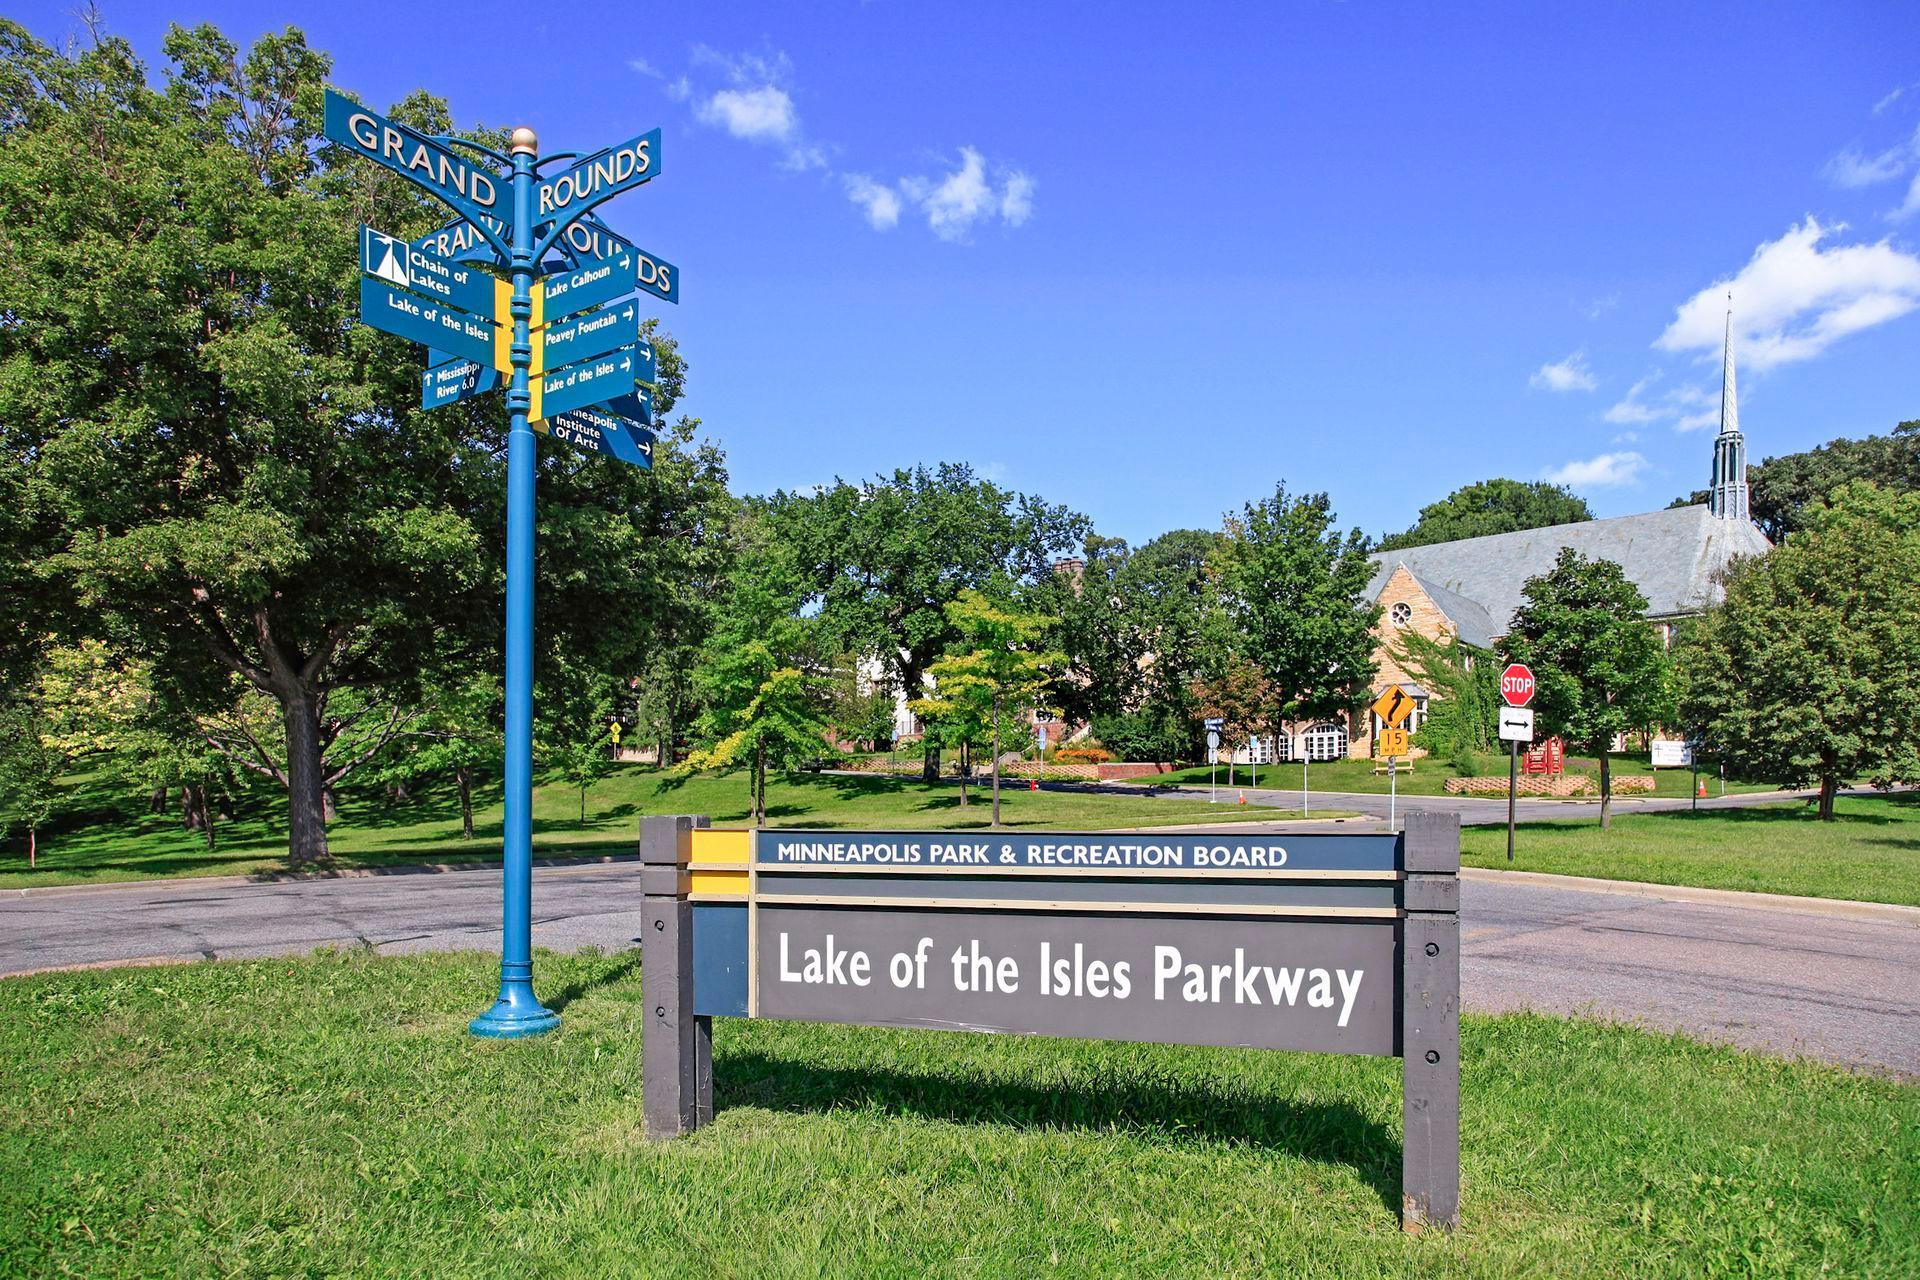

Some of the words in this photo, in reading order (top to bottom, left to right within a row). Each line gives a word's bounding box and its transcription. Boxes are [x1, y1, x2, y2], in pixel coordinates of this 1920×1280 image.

[349, 113, 496, 206] GRAND
[539, 140, 649, 215] ROUNDS
[410, 252, 449, 277] Chain
[454, 272, 468, 284] of
[410, 269, 451, 295] Lakes
[545, 282, 568, 299] Lake
[571, 266, 611, 288] Calhoun
[389, 293, 419, 316] Lake
[424, 310, 438, 322] of
[442, 315, 461, 330] the
[465, 322, 489, 342] Isles
[546, 328, 575, 346] Peavey
[578, 313, 617, 335] Fountain
[437, 384, 459, 398] River
[462, 377, 475, 390] 6.0
[544, 379, 564, 394] Lake
[567, 372, 577, 386] of
[579, 369, 593, 382] the
[596, 362, 615, 377] Isles
[556, 416, 600, 439] Institute
[567, 408, 618, 431] neapolis
[556, 426, 571, 440] Of
[574, 433, 599, 450] Arts
[1503, 676, 1532, 694] STOP
[1387, 733, 1402, 745] 15
[778, 843, 921, 863] MINNEAPOLIS
[930, 844, 990, 864] PARK
[999, 845, 1017, 864] &
[1027, 845, 1183, 866] RECREATION
[1193, 846, 1288, 867] BOARD
[780, 932, 872, 987] Lake
[889, 936, 934, 989] of
[951, 939, 1019, 994] the
[1040, 942, 1131, 1000] Isles
[1154, 945, 1364, 1027] Parkway
